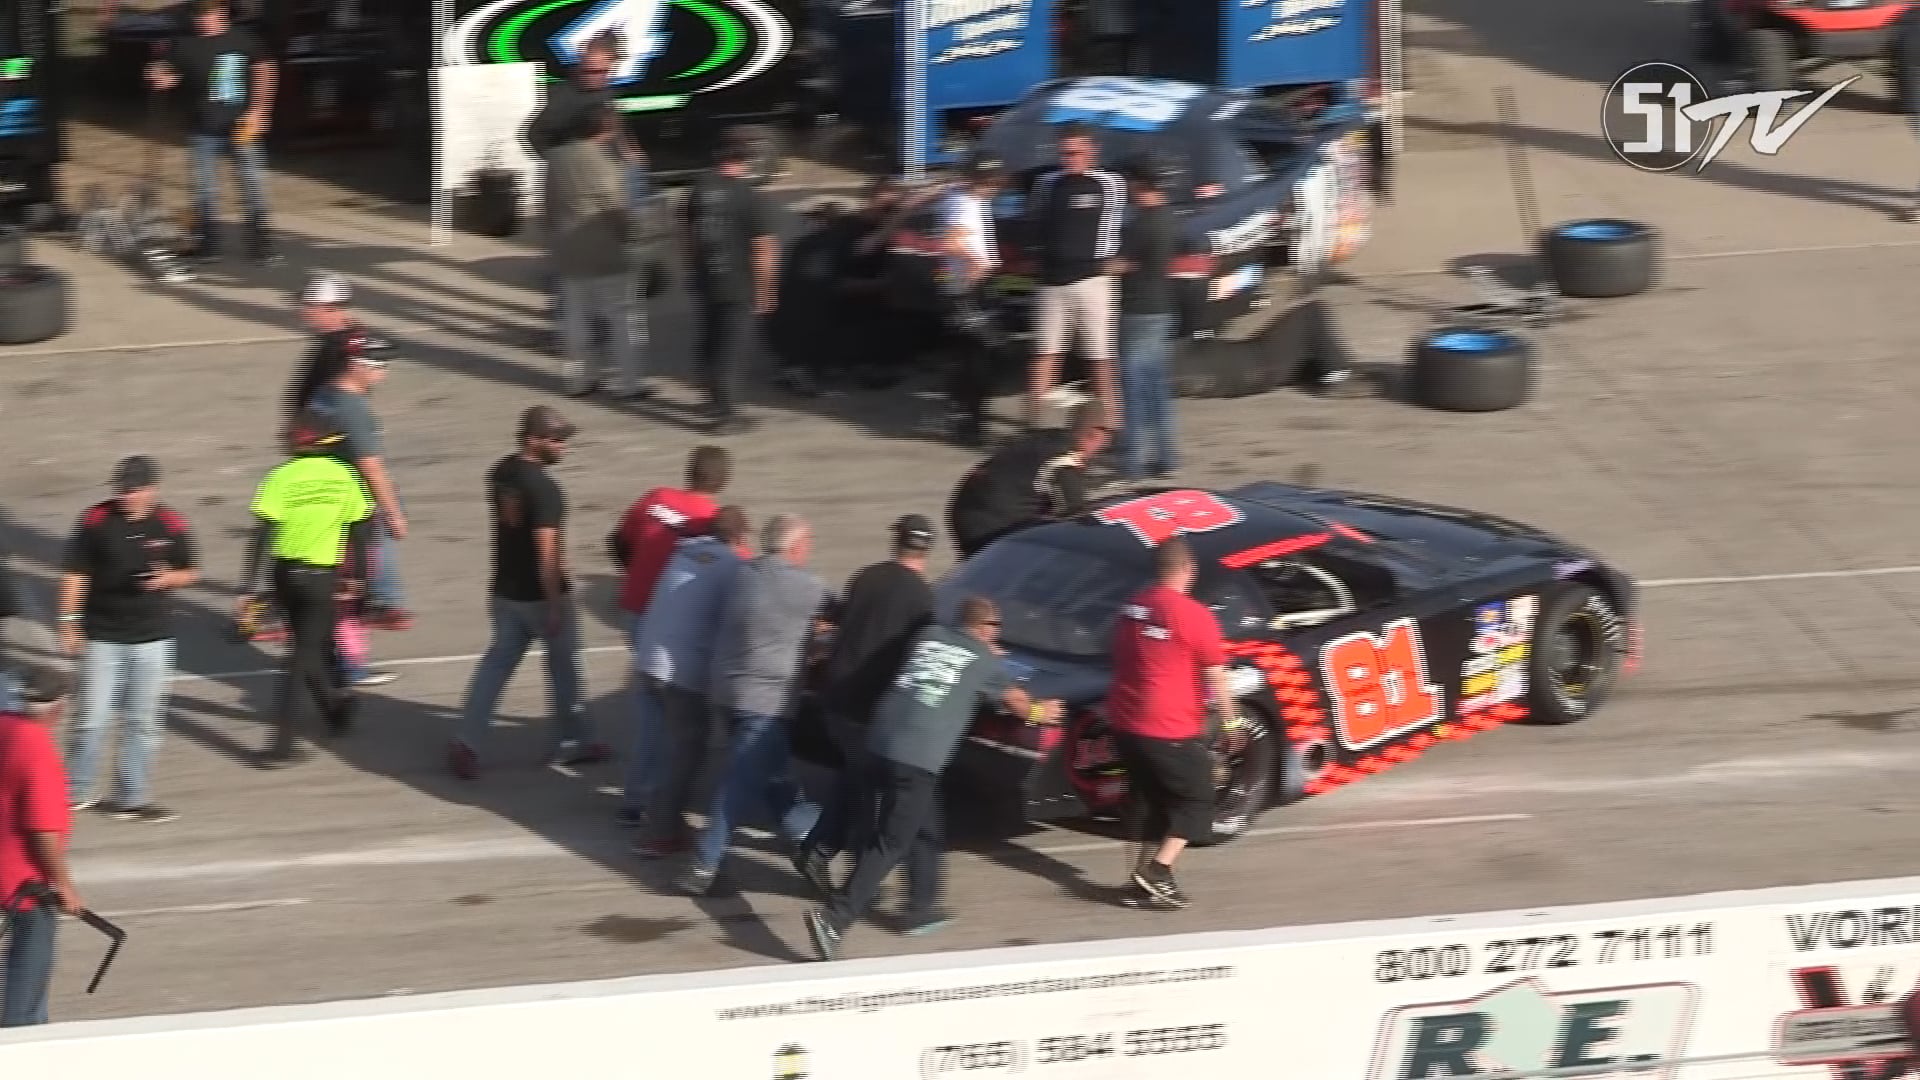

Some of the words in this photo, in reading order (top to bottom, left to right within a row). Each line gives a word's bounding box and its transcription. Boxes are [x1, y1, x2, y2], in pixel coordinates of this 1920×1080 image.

[1320, 617, 1445, 750] 81
[1375, 945, 1472, 983] 800
[1482, 933, 1581, 974] 272
[1592, 921, 1717, 964] 7111
[919, 1039, 1030, 1080] (765)
[1036, 1031, 1117, 1065] 584
[1122, 1021, 1229, 1058] 5555
